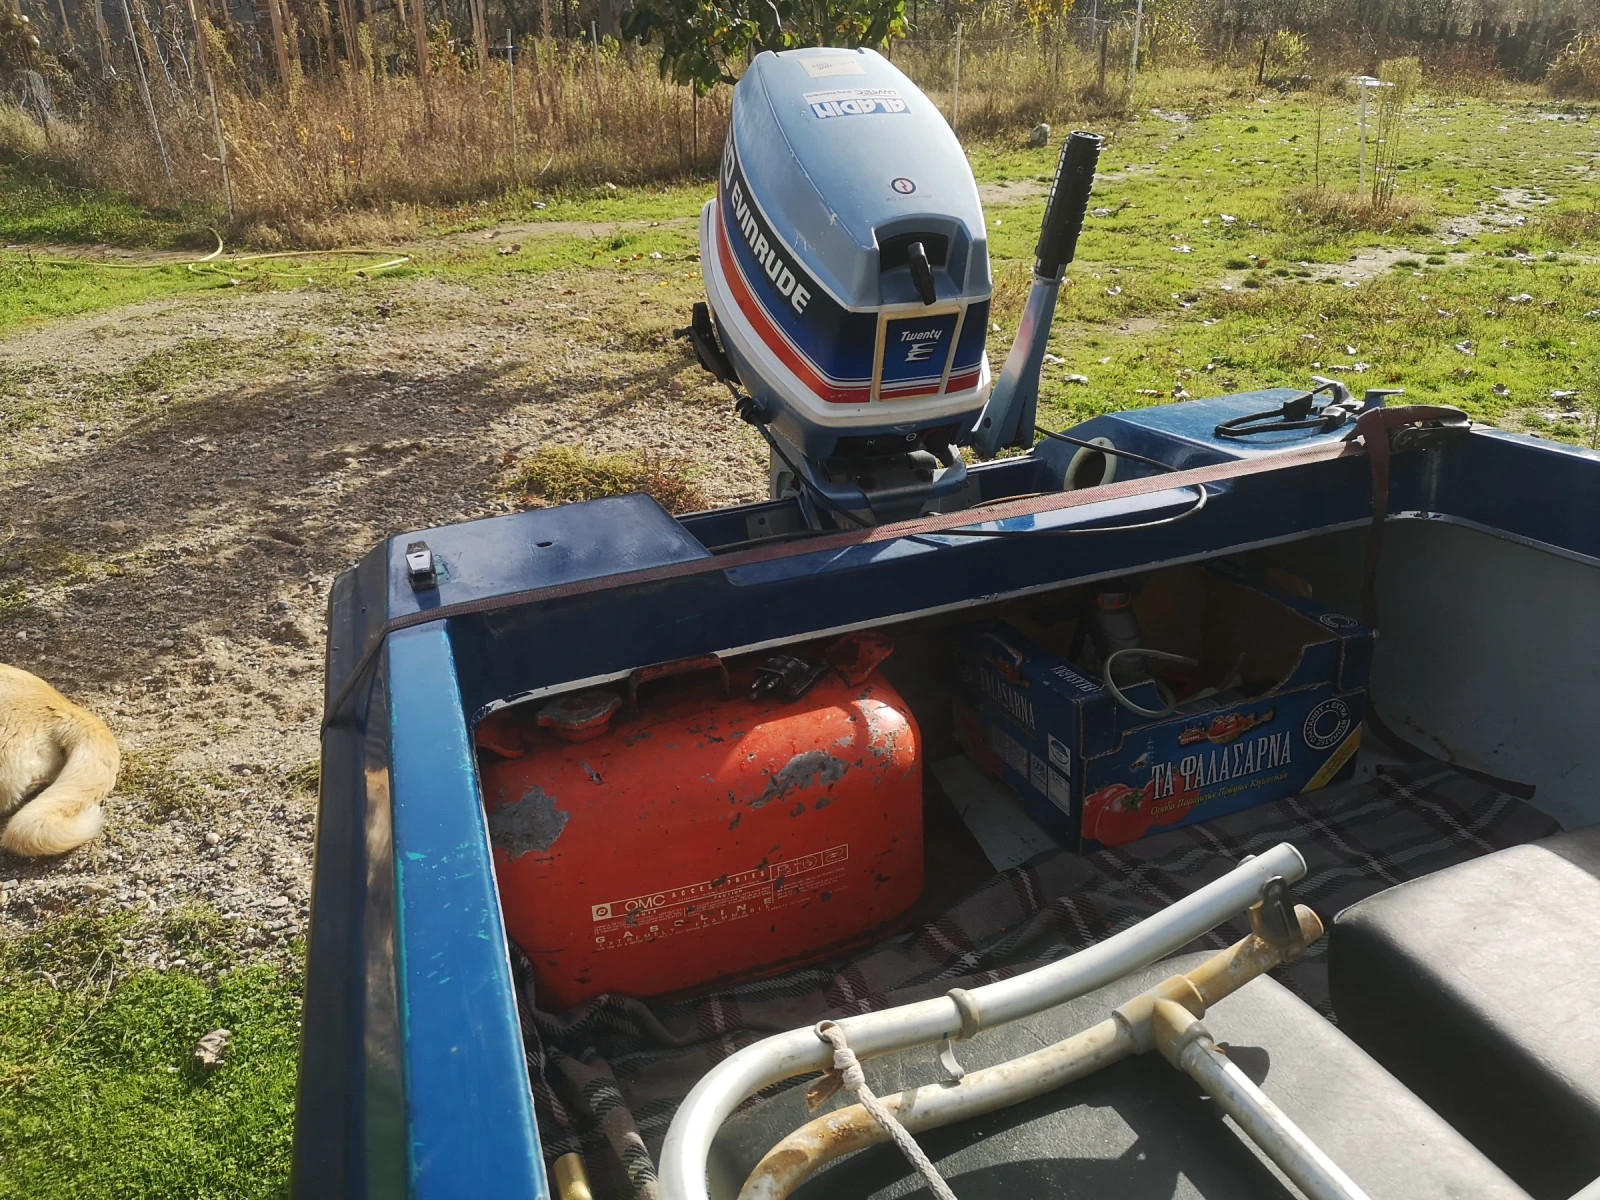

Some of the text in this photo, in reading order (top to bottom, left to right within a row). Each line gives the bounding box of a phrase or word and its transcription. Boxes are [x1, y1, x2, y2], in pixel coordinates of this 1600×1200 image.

[811, 98, 905, 119] ALADIN
[731, 180, 812, 315] EVINRUDE
[900, 328, 943, 342] Twenty
[1150, 762, 1176, 800] ΤΑ
[1179, 730, 1293, 792] ΦΑΛΑΣΑΡΝΑ
[625, 894, 666, 912] OMC
[671, 870, 765, 898] ACCESORIES
[599, 928, 675, 948] EXTREMELY
[695, 904, 770, 927] FLAMMABLE
